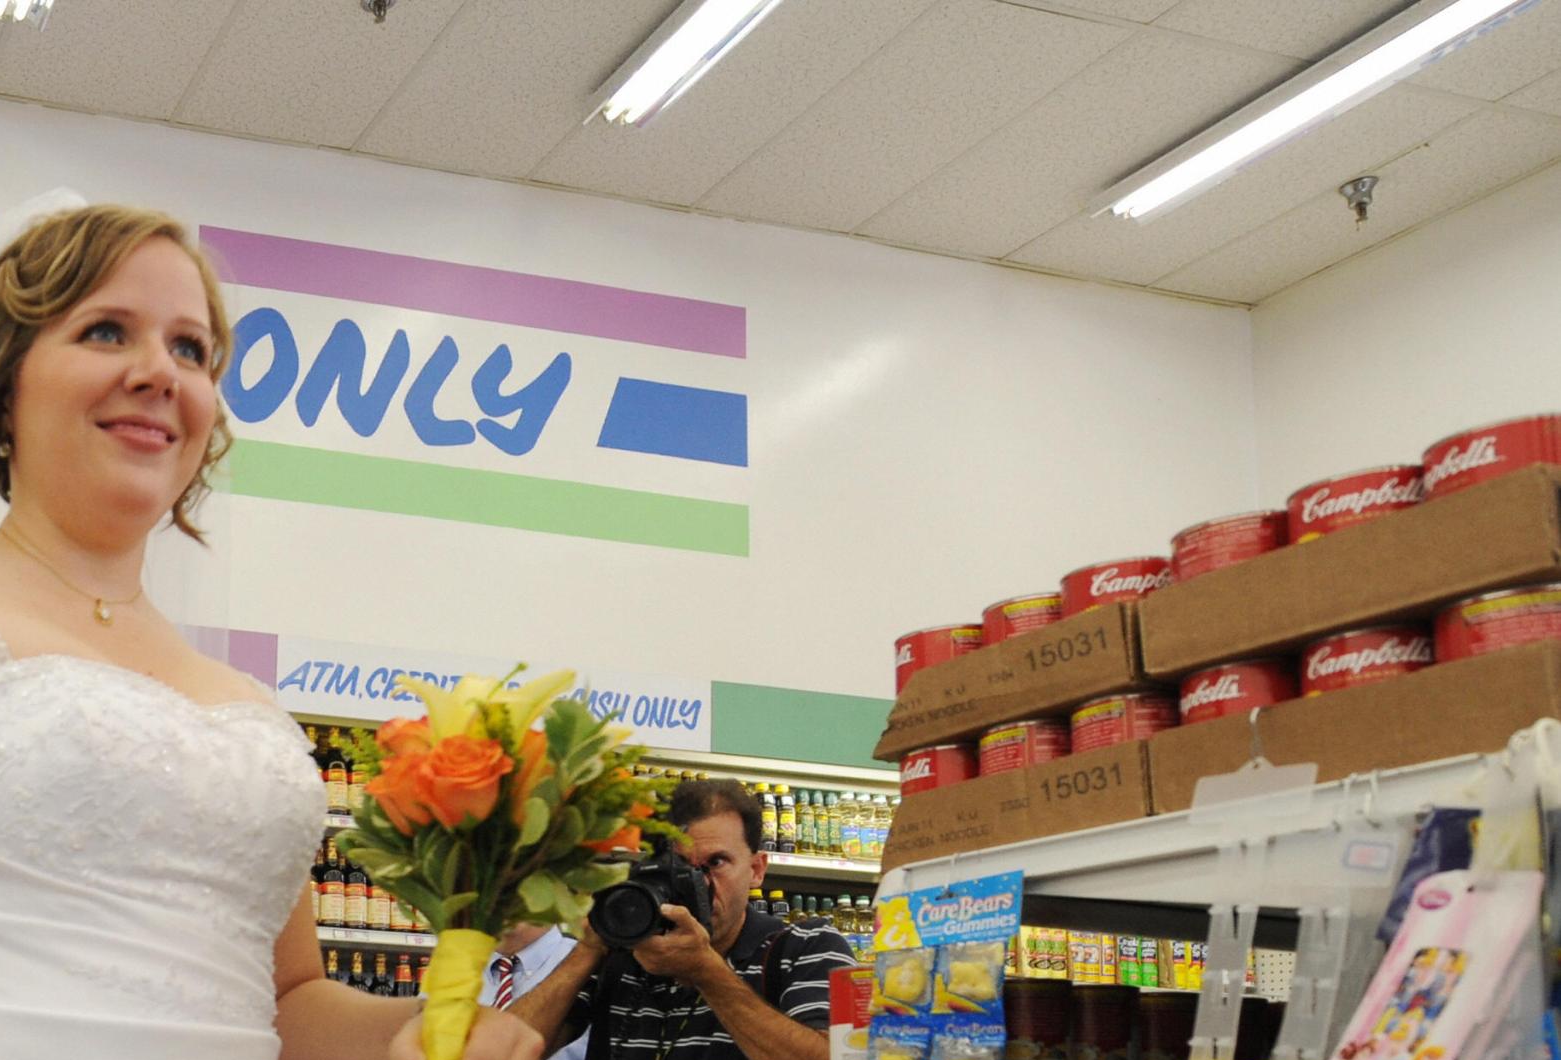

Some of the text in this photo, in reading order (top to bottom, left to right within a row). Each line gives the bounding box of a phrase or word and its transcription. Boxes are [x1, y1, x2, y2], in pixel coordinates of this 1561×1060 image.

[221, 307, 572, 456] ONLY
[1091, 567, 1173, 597] Campb
[1024, 627, 1109, 672] 15031
[632, 694, 702, 731] ONLY
[1040, 762, 1125, 802] 15031
[944, 914, 1017, 935] Gummies
